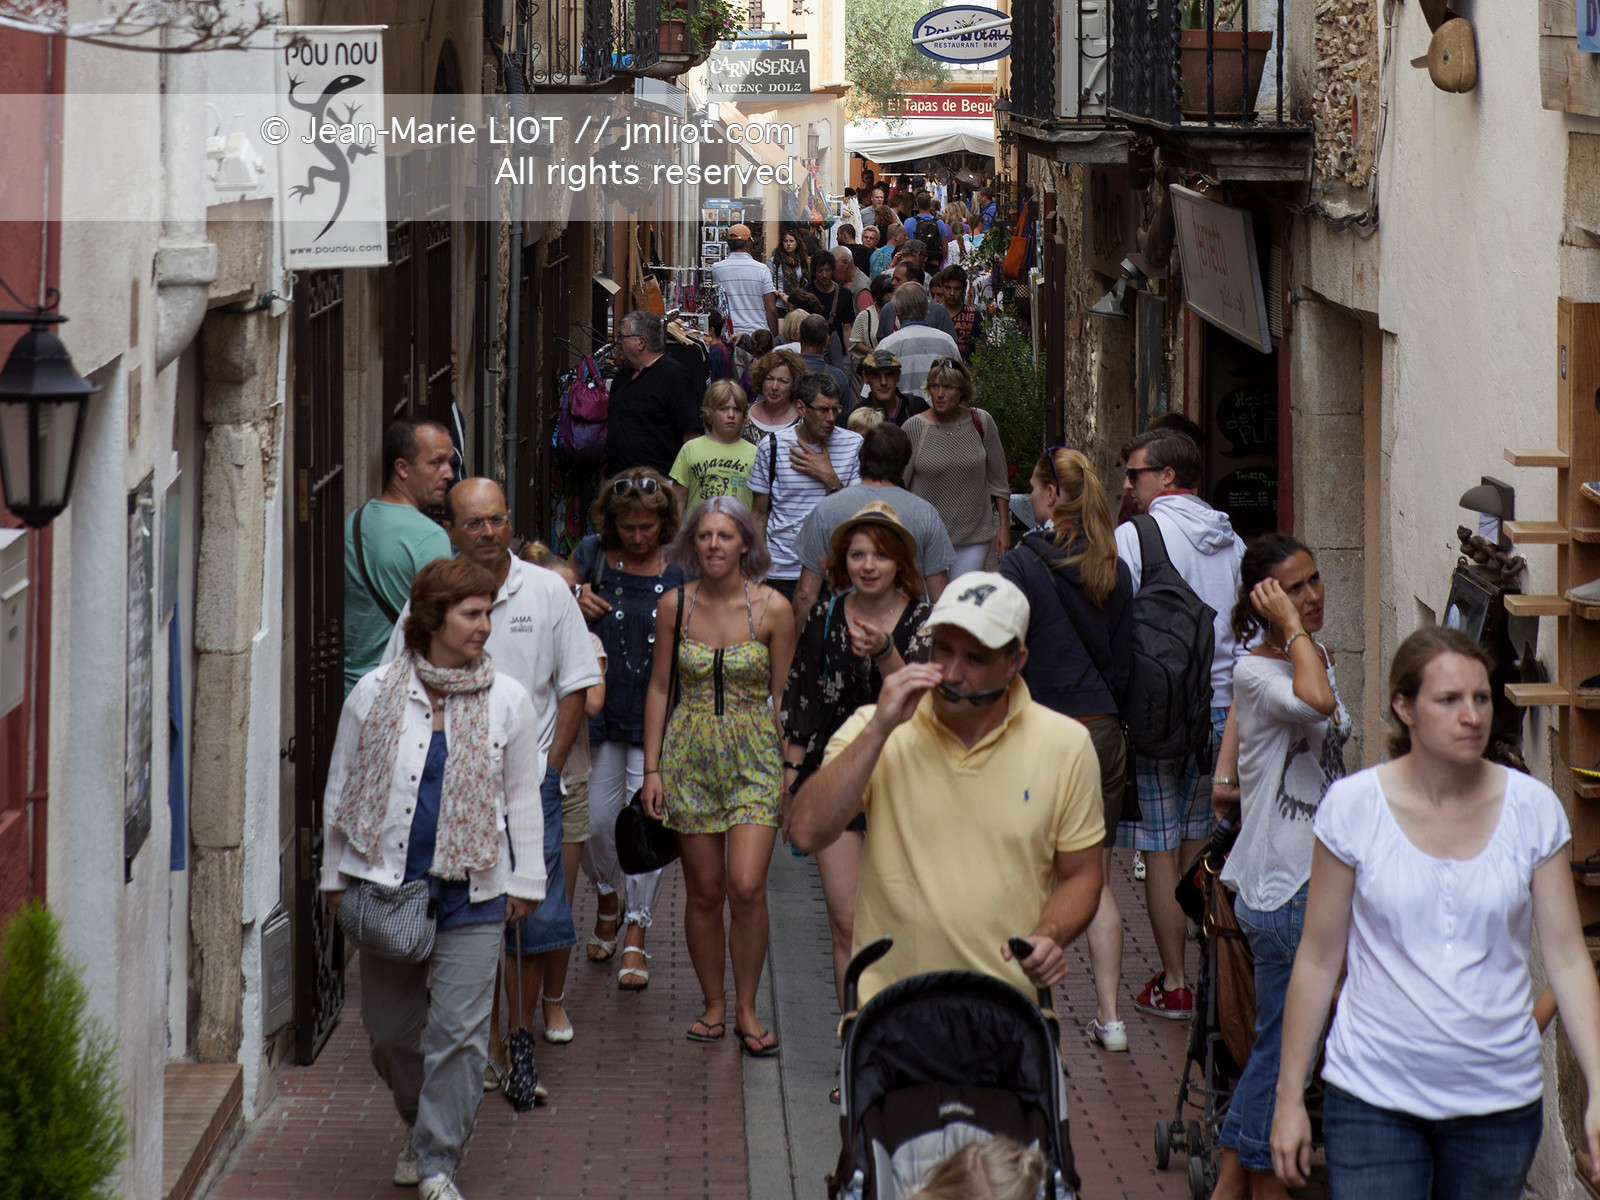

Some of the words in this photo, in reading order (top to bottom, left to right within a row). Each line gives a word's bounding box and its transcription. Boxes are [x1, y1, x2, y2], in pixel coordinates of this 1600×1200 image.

[285, 43, 328, 66] POU
[710, 56, 807, 78] CARNISSERIA
[718, 83, 762, 95] VICENÇ
[768, 83, 802, 92] DOLZ
[904, 99, 938, 113] Tapas
[942, 99, 957, 112] de
[961, 99, 993, 114] Begu
[289, 244, 383, 255] www.pounou.com
